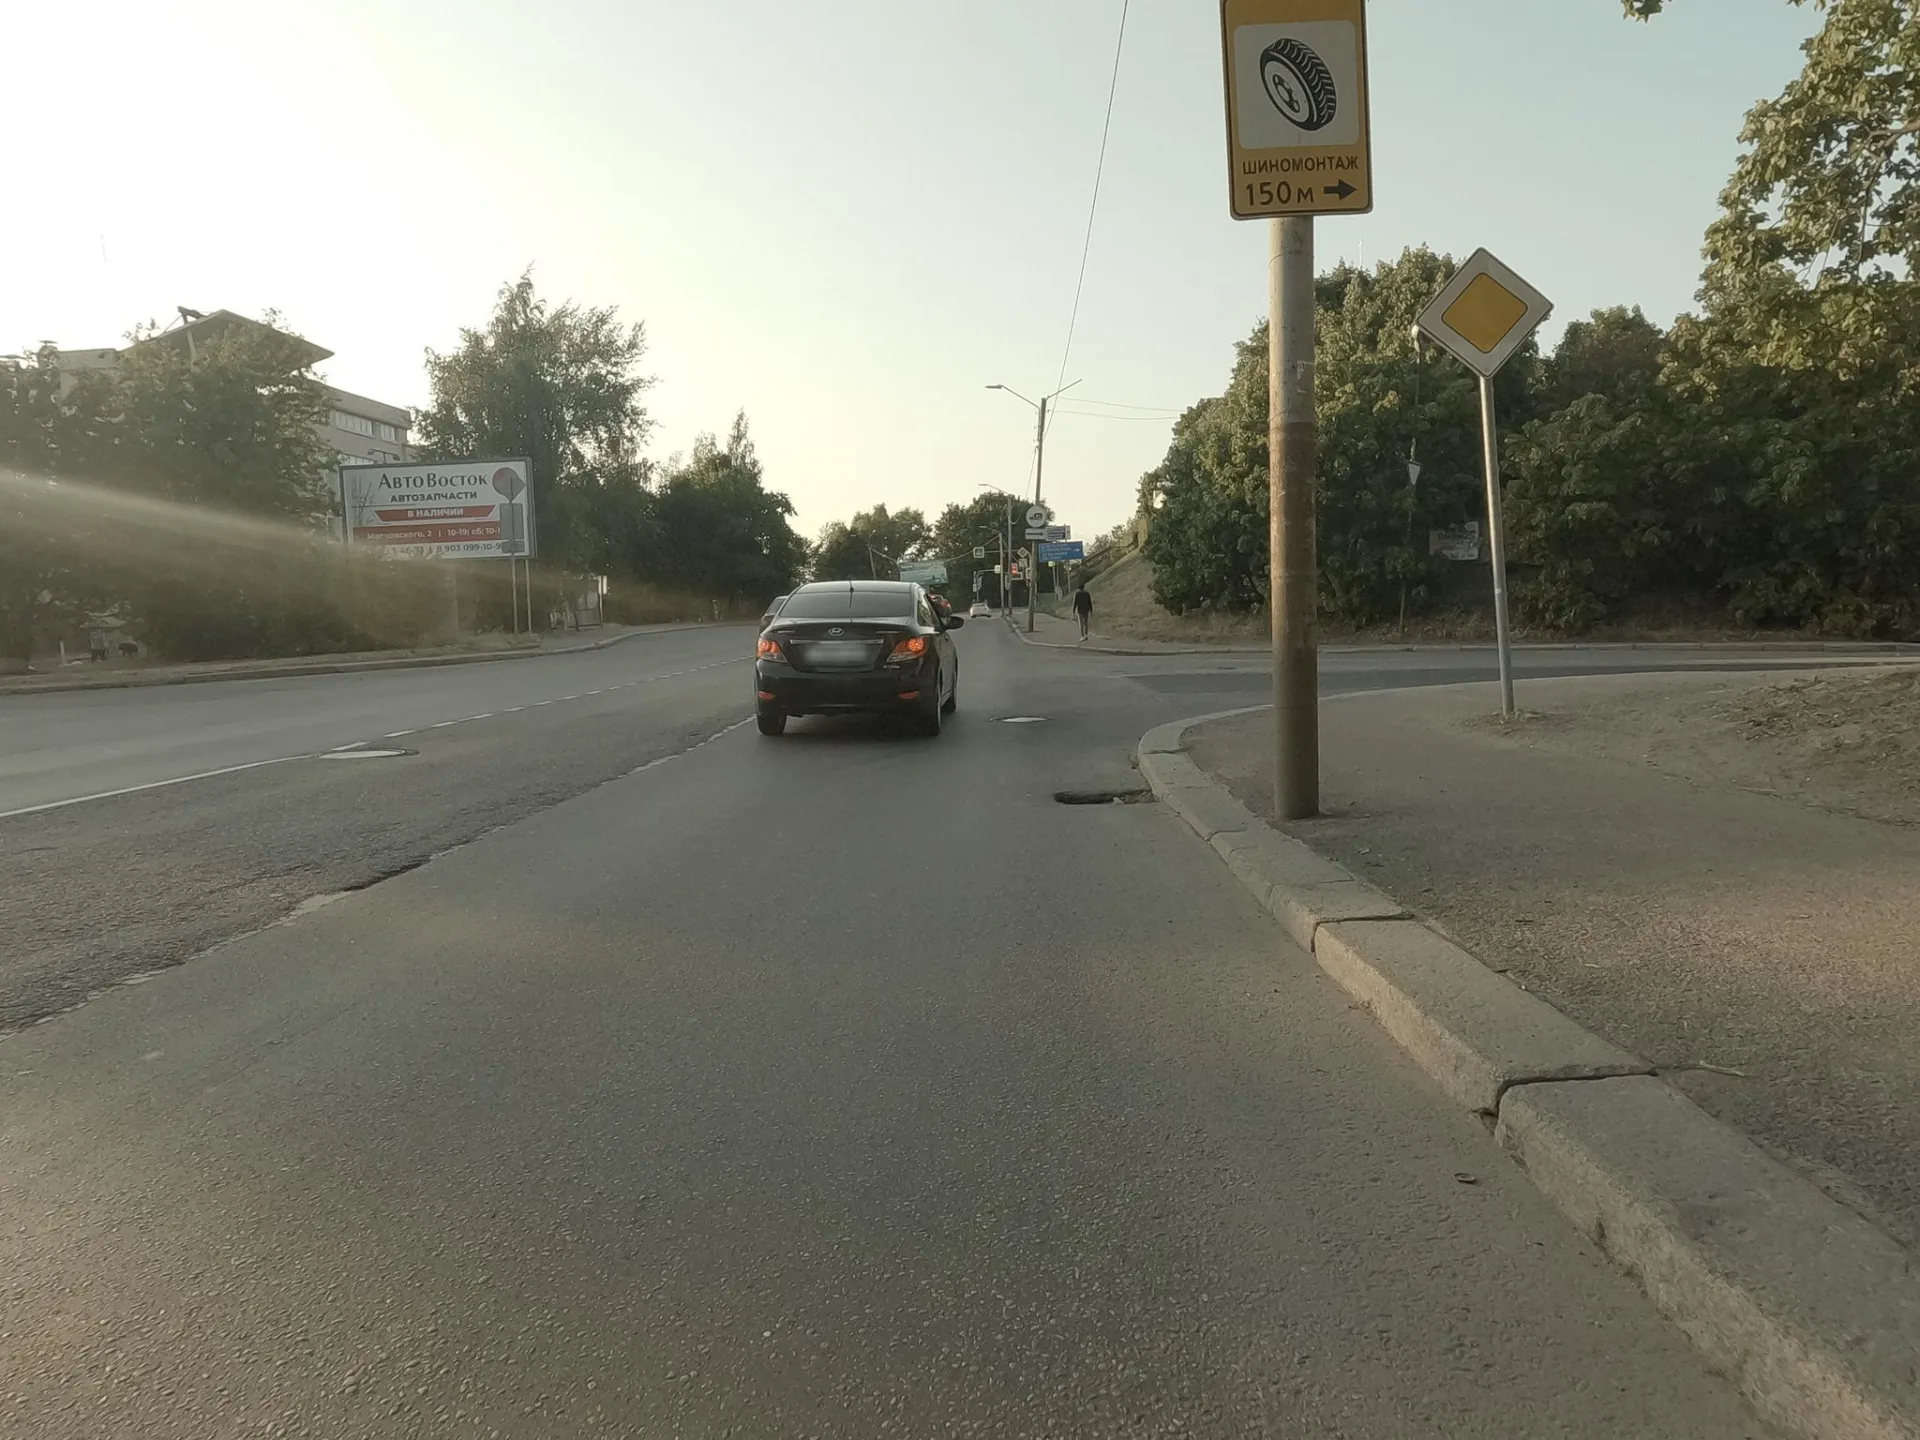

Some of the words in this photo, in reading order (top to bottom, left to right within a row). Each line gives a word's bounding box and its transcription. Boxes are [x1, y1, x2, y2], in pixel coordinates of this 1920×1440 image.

[1242, 156, 1358, 175] ШИНОМОНТАЖ
[1245, 181, 1292, 206] 150
[390, 491, 478, 503] АВТОЗАПЧАСТИ
[416, 508, 464, 518] НАЛИЧИИ
[426, 530, 433, 538] 2
[444, 544, 460, 552] 903
